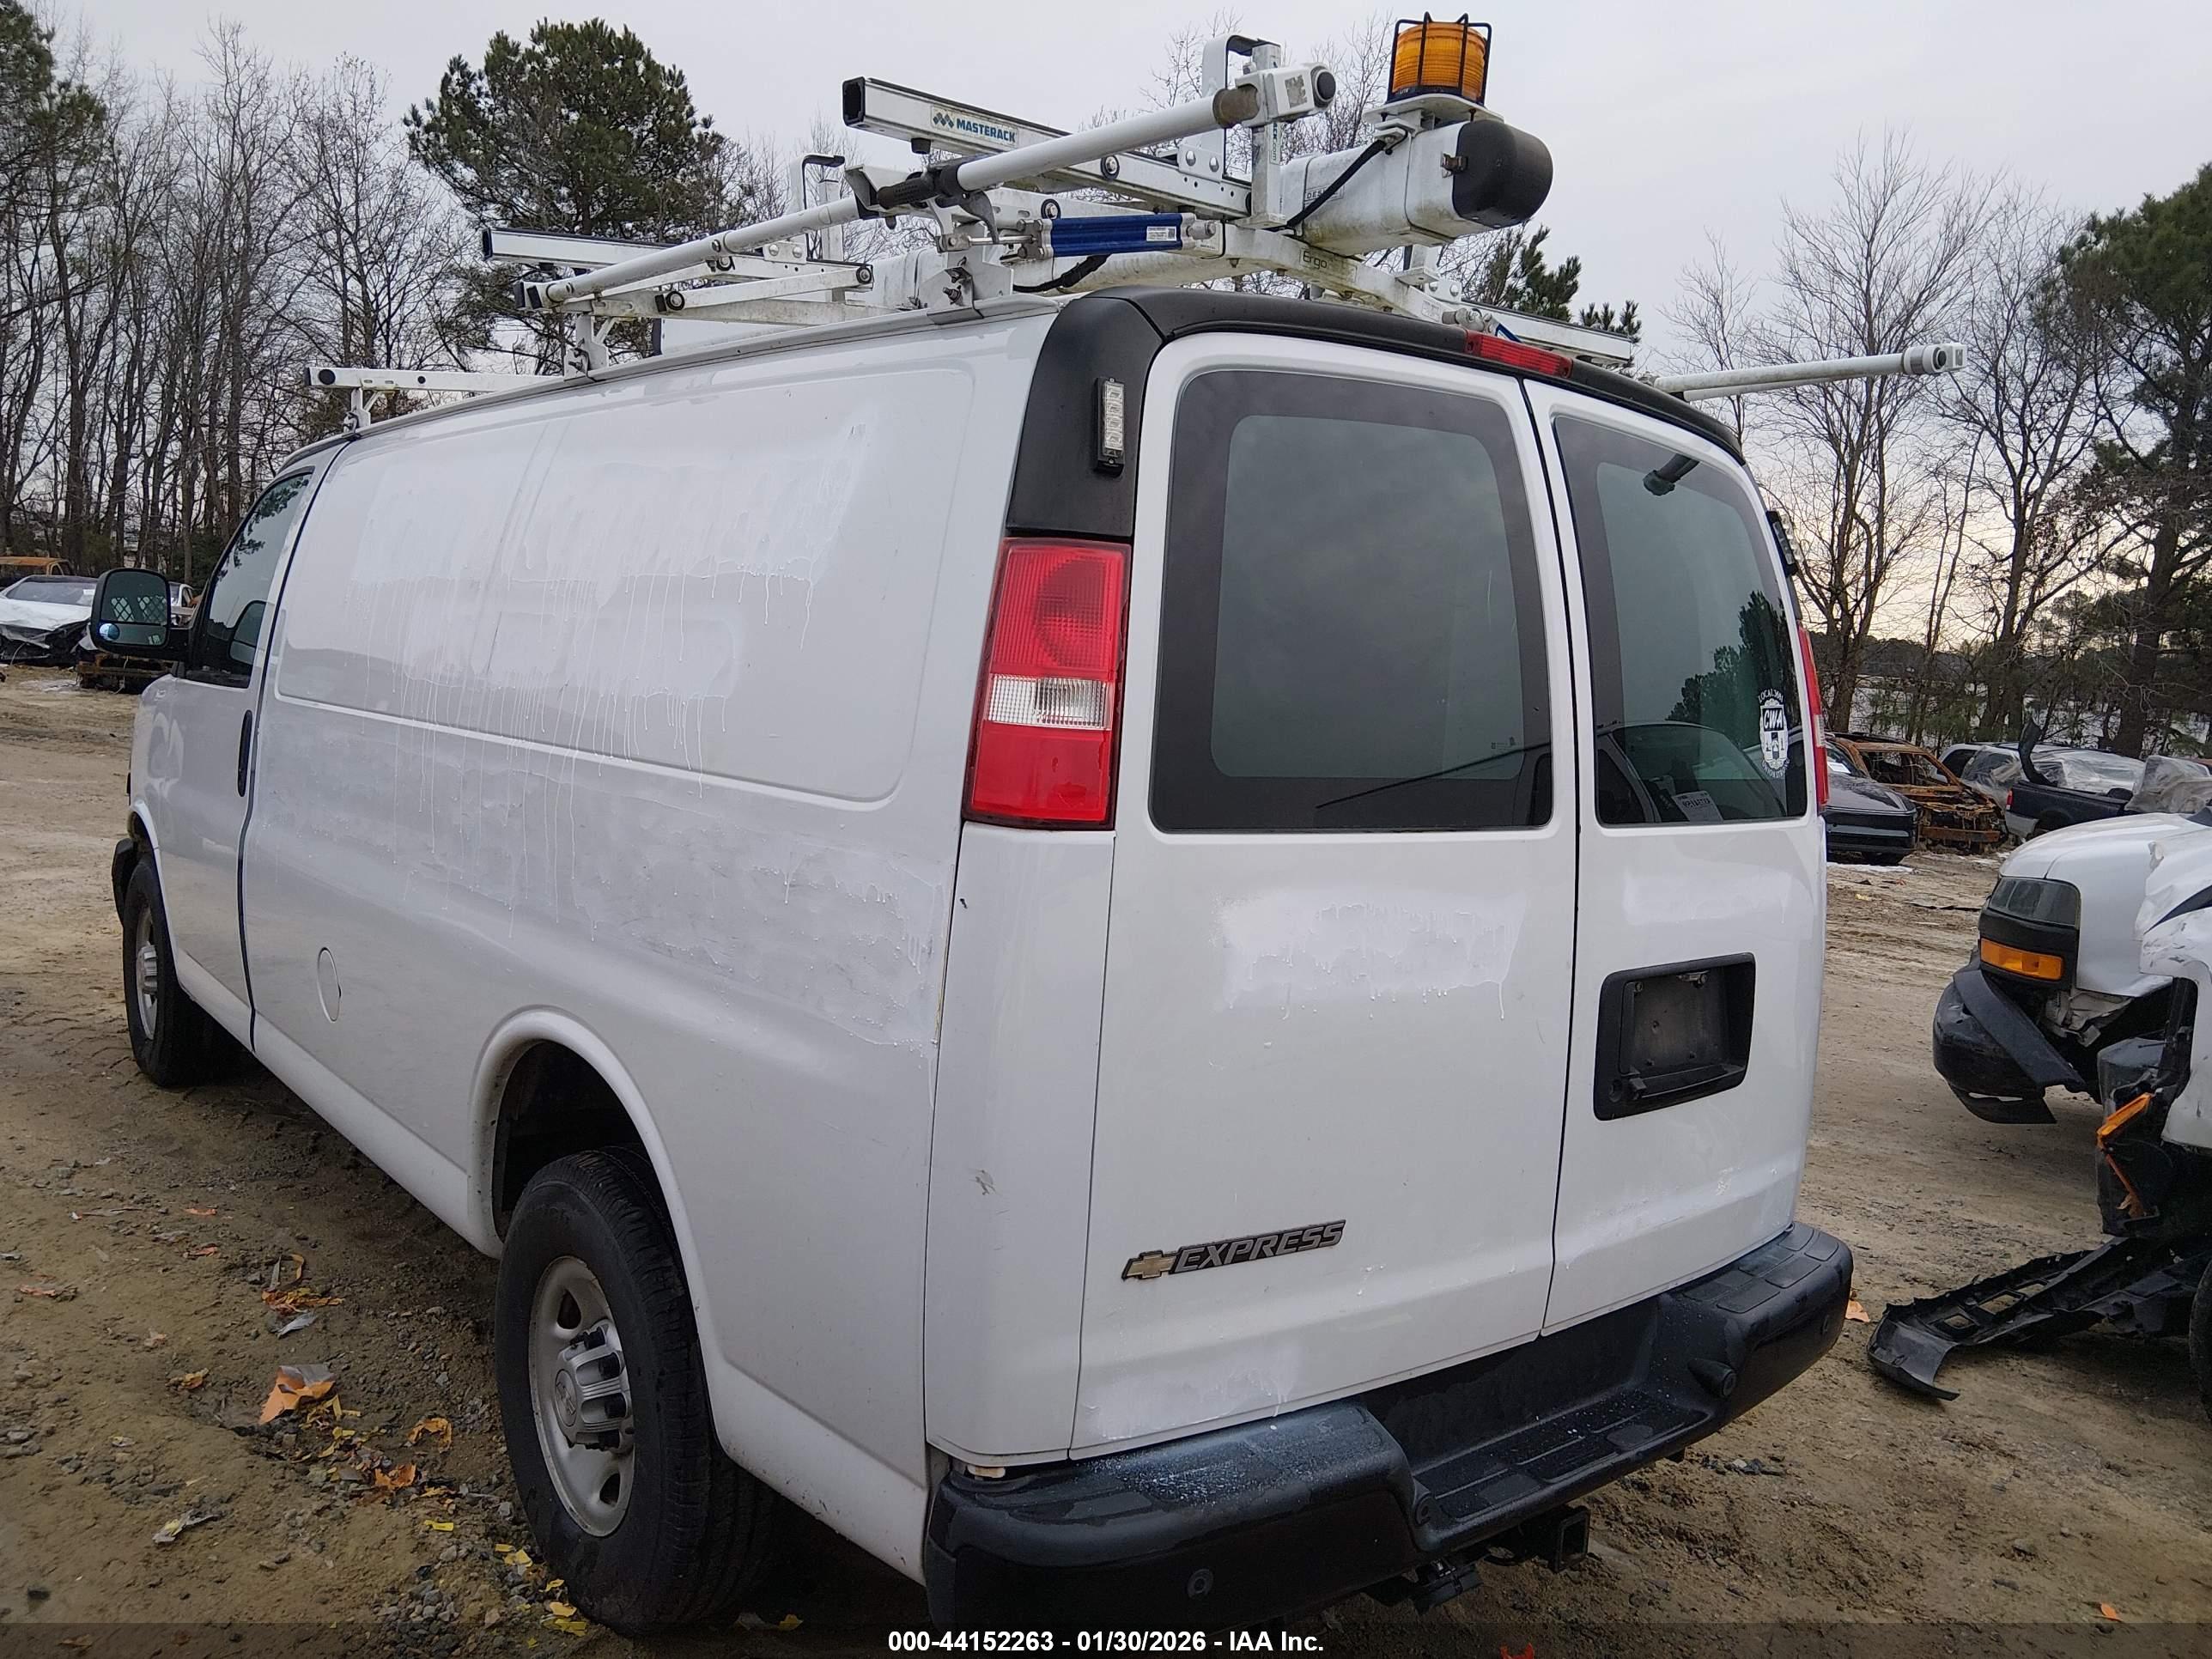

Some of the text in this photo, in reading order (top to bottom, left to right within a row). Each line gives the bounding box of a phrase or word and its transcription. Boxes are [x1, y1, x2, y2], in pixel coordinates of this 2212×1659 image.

[957, 118, 1016, 143] MASTERACK
[1303, 250, 1328, 270] Ergo
[1758, 688, 1774, 704] LOCAL
[1764, 709, 1783, 729] CWA
[1174, 1222, 1345, 1273] EXPRESS
